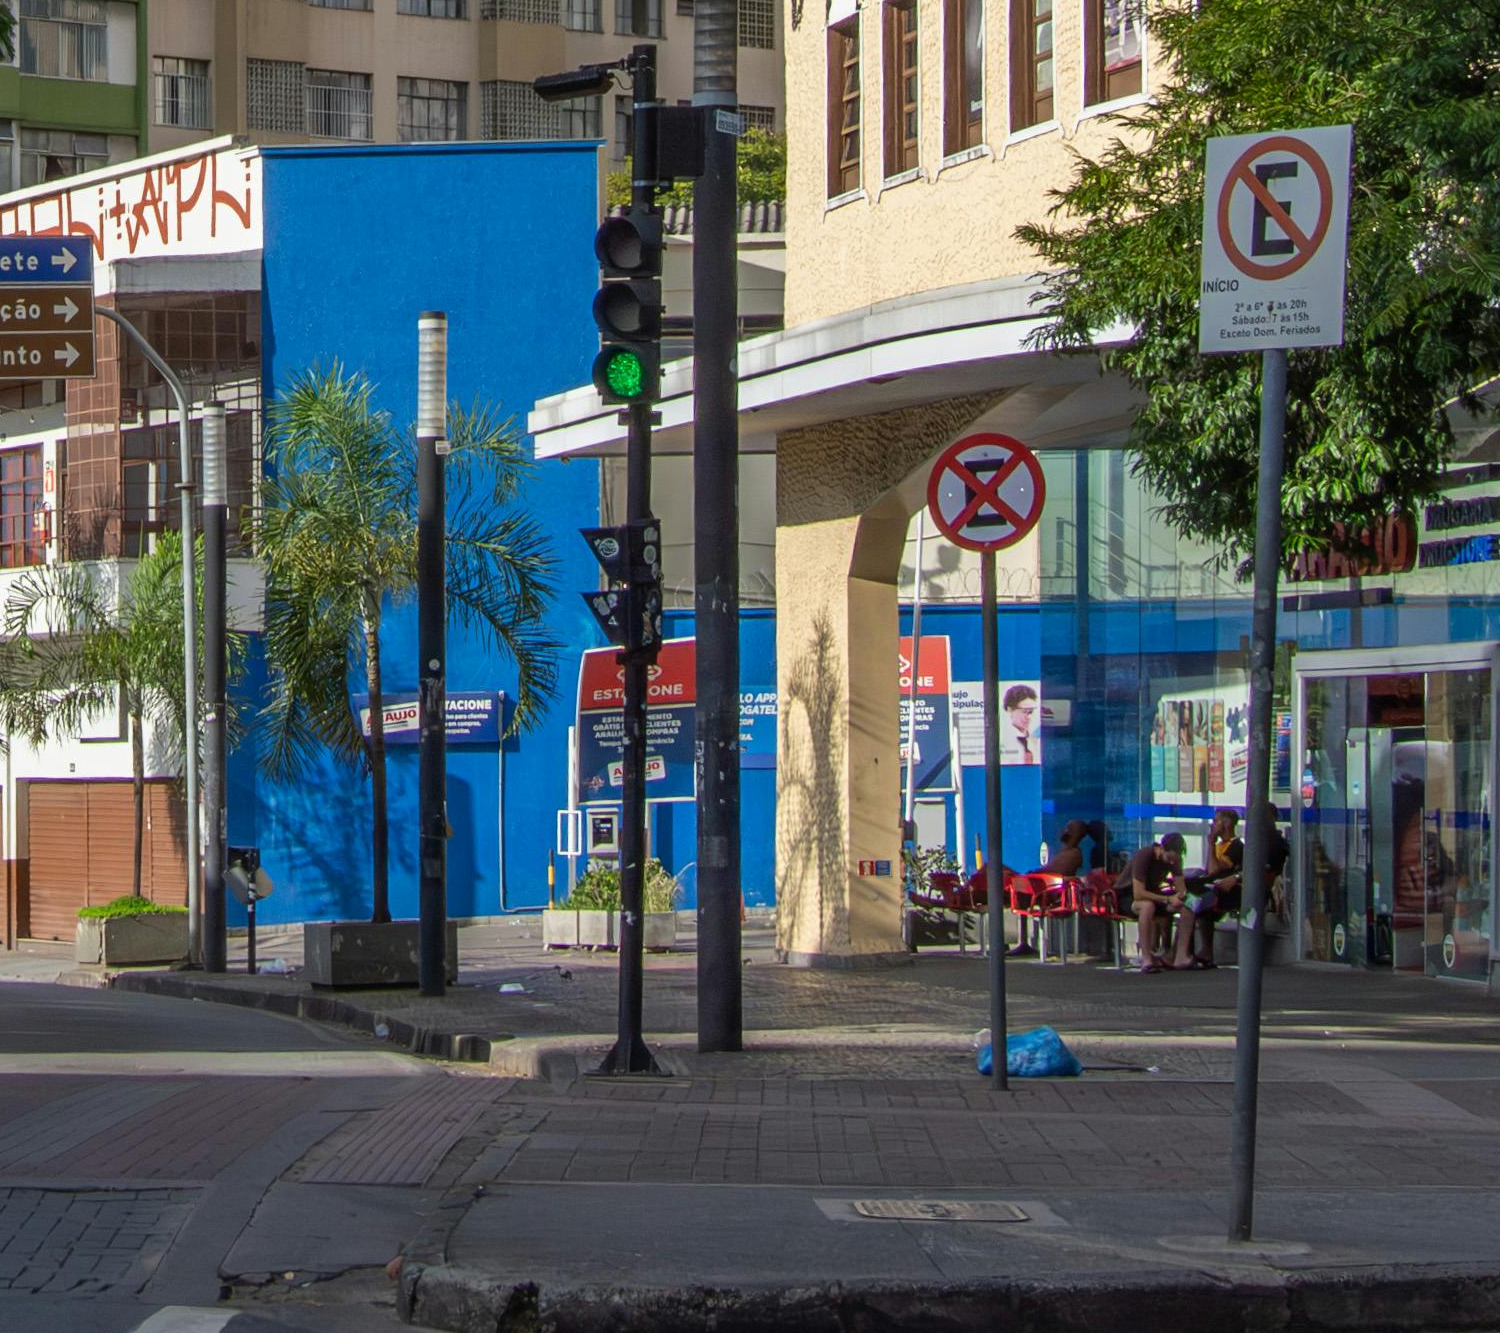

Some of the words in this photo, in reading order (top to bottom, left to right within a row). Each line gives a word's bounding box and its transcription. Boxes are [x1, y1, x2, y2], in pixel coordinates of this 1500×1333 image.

[1203, 277, 1239, 293] INÍCIO
[1290, 299, 1307, 310] 20h
[1293, 312, 1309, 322] 15h
[1220, 327, 1251, 339] Exceto
[1280, 325, 1321, 335] Feriados
[593, 683, 683, 701] ESTONE
[952, 690, 968, 700] ujo
[445, 699, 492, 711] TACIONE
[646, 727, 679, 736] OMPRAS
